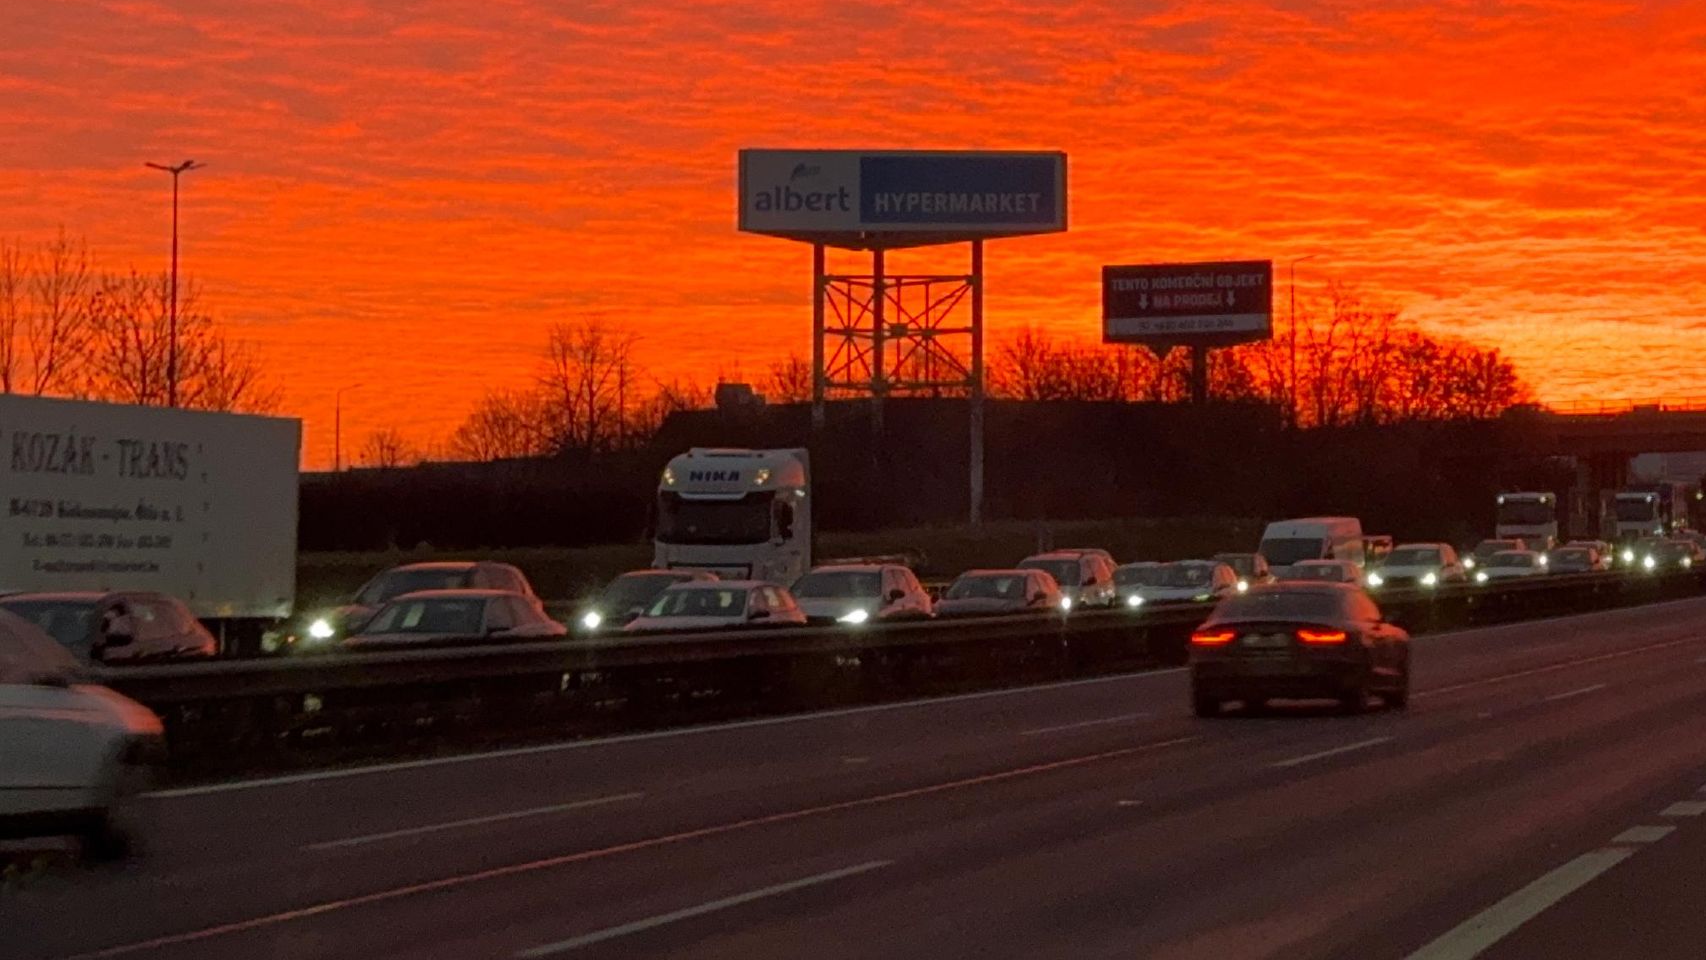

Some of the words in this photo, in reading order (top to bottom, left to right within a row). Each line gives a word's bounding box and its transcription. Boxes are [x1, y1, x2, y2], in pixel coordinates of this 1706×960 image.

[755, 185, 850, 213] albert
[874, 192, 1042, 214] HYPERMARKET
[1112, 278, 1149, 291] TENTO
[1151, 272, 1214, 290] KOMERČNÍ
[1216, 273, 1264, 288] OBJEKT
[10, 425, 96, 475] KOZÁK
[116, 438, 189, 481] TRANS
